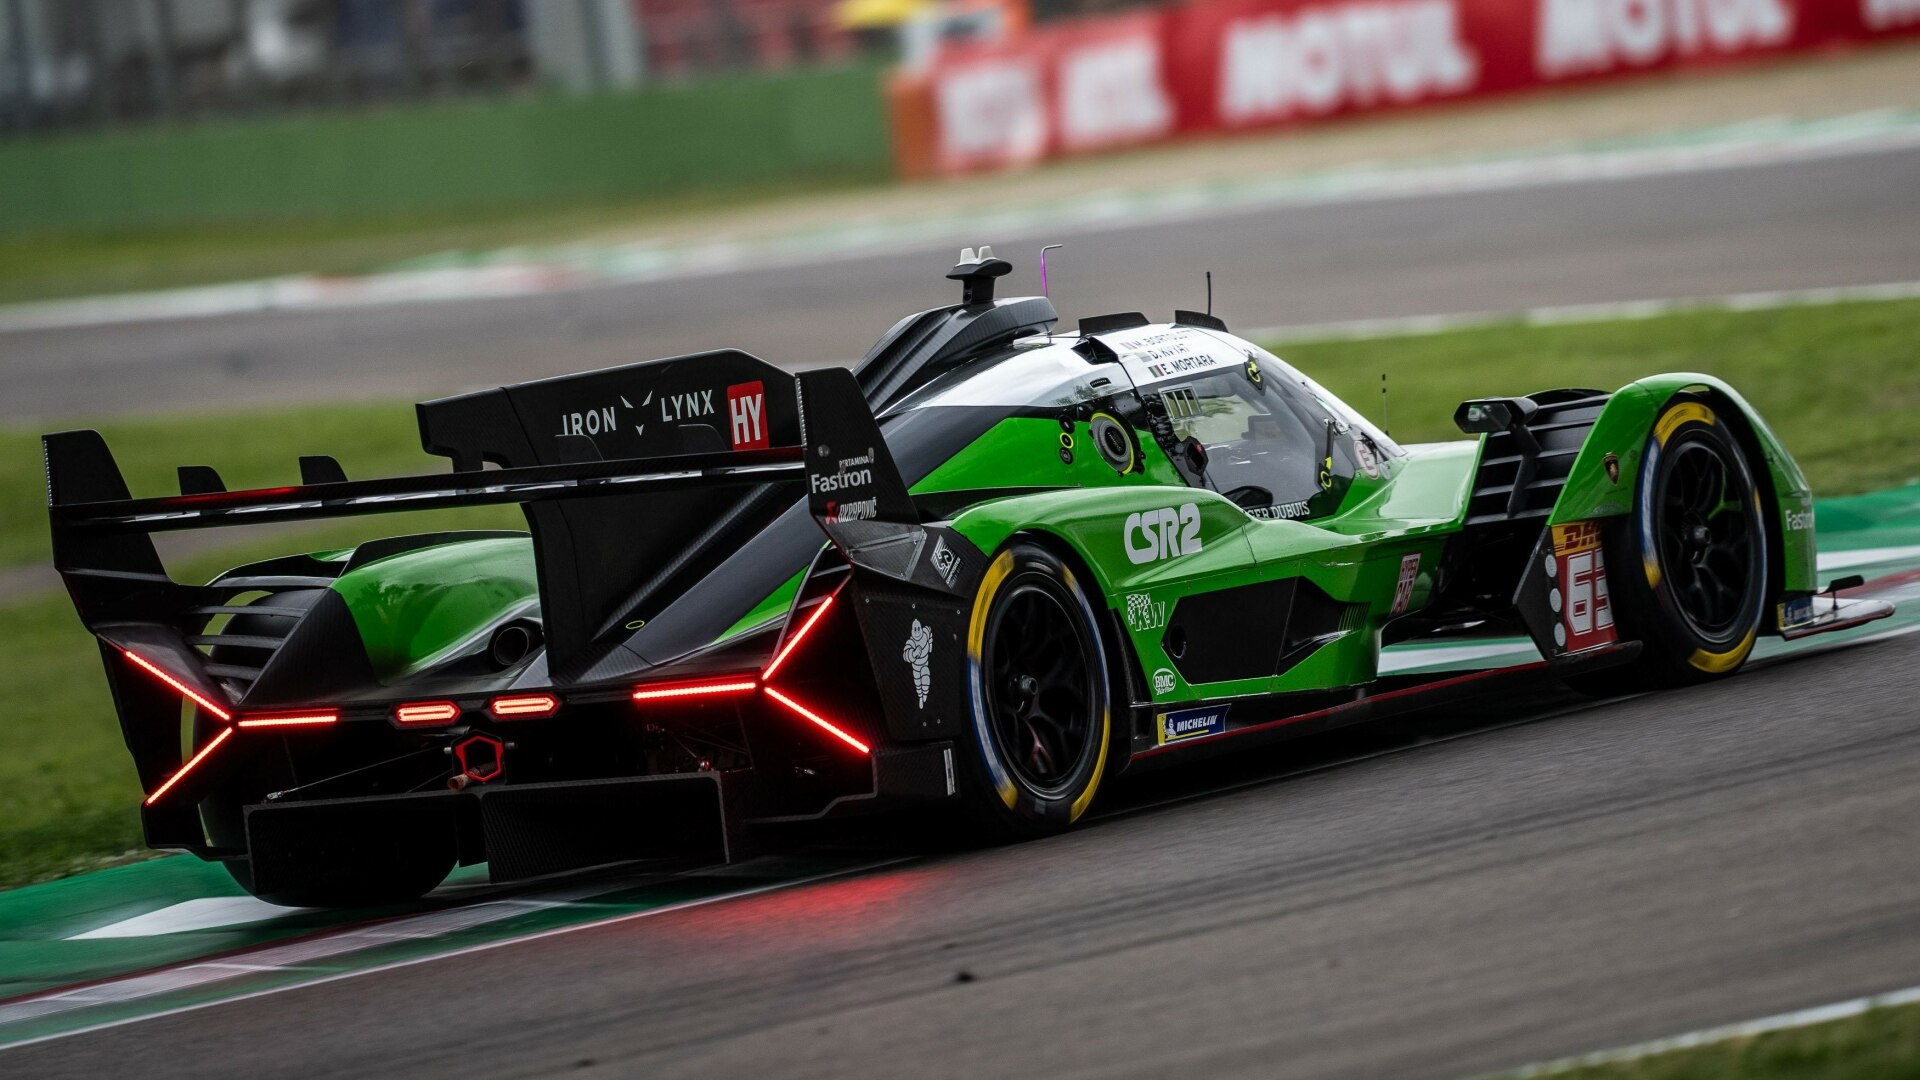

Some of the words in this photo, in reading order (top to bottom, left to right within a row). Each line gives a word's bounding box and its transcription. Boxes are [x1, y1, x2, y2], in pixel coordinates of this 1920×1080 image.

[1161, 363, 1174, 375] E.
[1170, 354, 1217, 373] MORTARA
[562, 406, 617, 435] IRON
[660, 389, 715, 422] LYNX
[730, 393, 762, 445] HY
[810, 469, 872, 494] Fastron
[1271, 501, 1310, 519] DUBUIS
[1124, 503, 1203, 565] CSR2
[1154, 674, 1174, 688] BMC
[1176, 714, 1218, 733] MICHELIN
